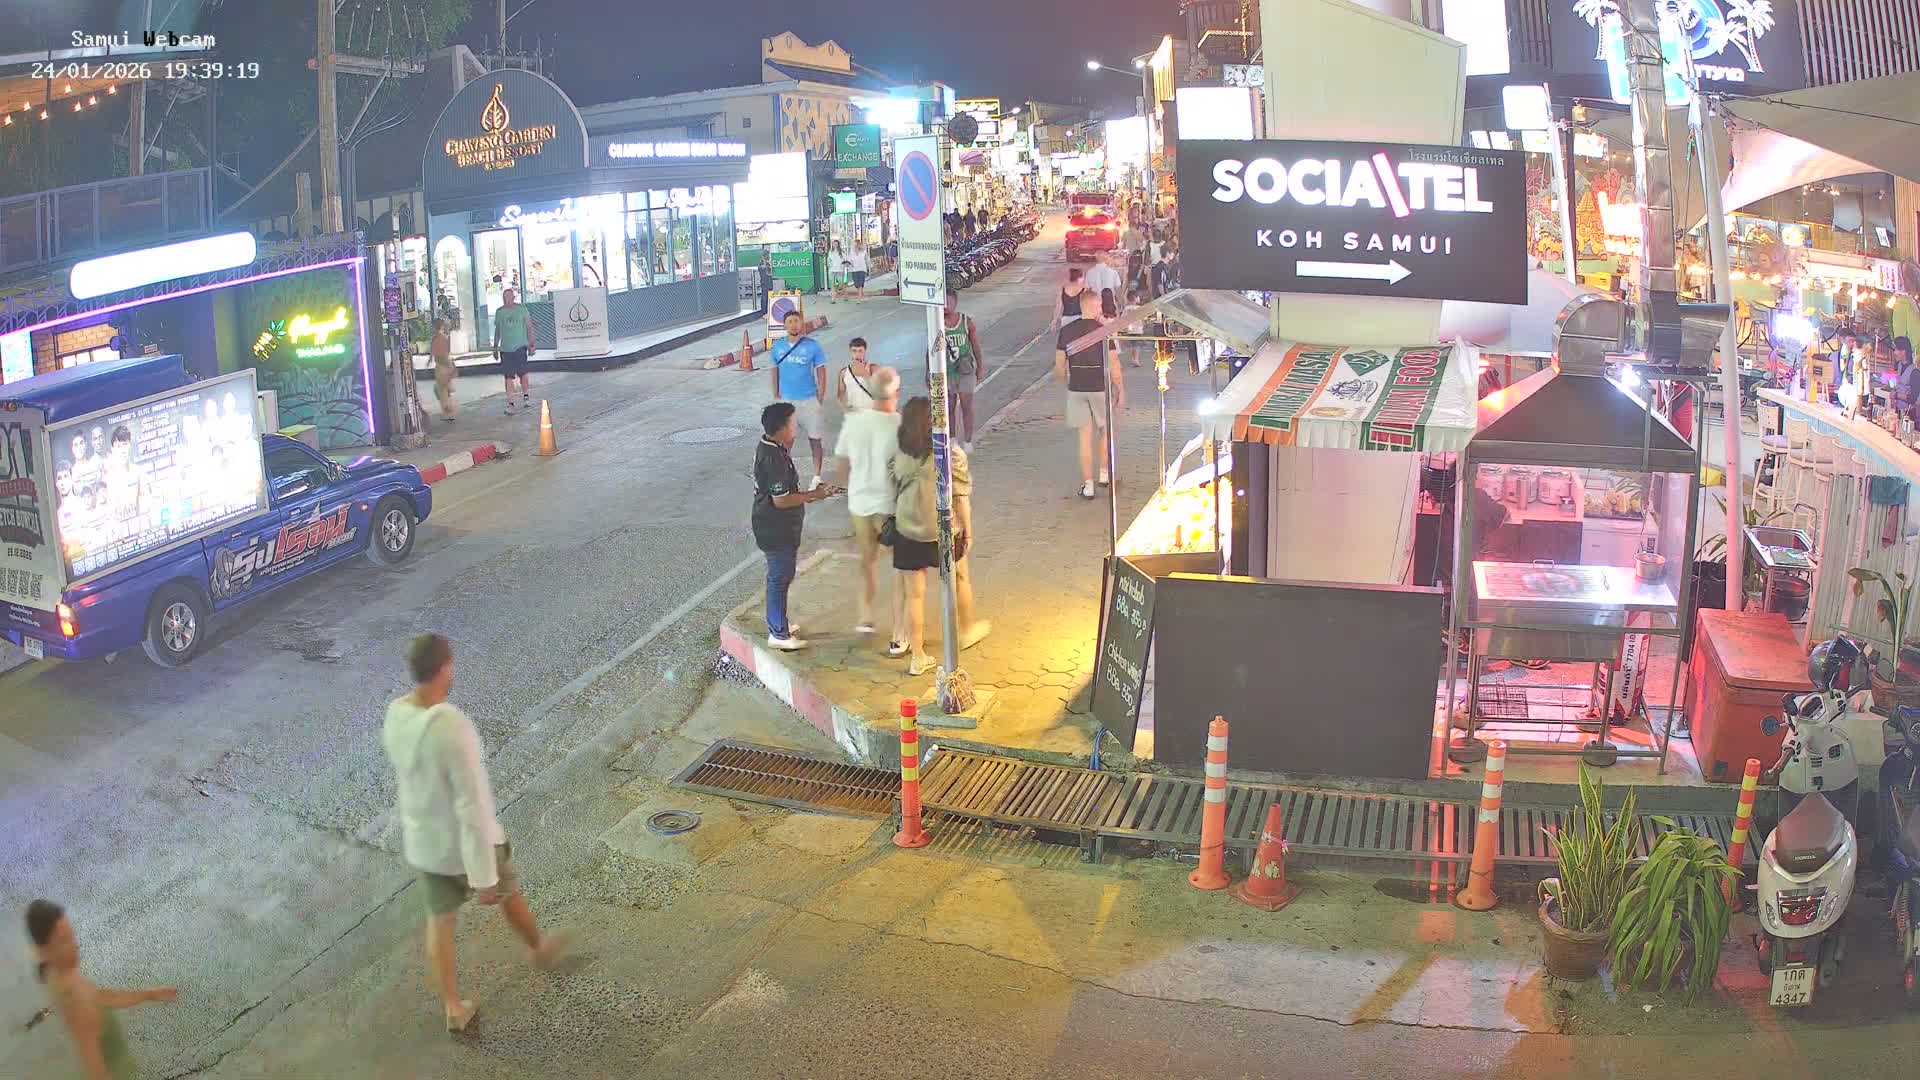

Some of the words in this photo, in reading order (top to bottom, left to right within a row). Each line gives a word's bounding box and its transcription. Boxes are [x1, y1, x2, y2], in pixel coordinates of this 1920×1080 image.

[838, 152, 878, 162] EXCHANGE
[1256, 229, 1322, 249] KOH
[1343, 232, 1451, 255] SAMUI
[772, 257, 811, 268] EXCHANGE
[905, 261, 913, 270] NO
[914, 260, 937, 272] PARKING
[1368, 388, 1431, 448] INDIAN
[1626, 644, 1635, 662] 7704
[1776, 992, 1807, 1005] 4347
